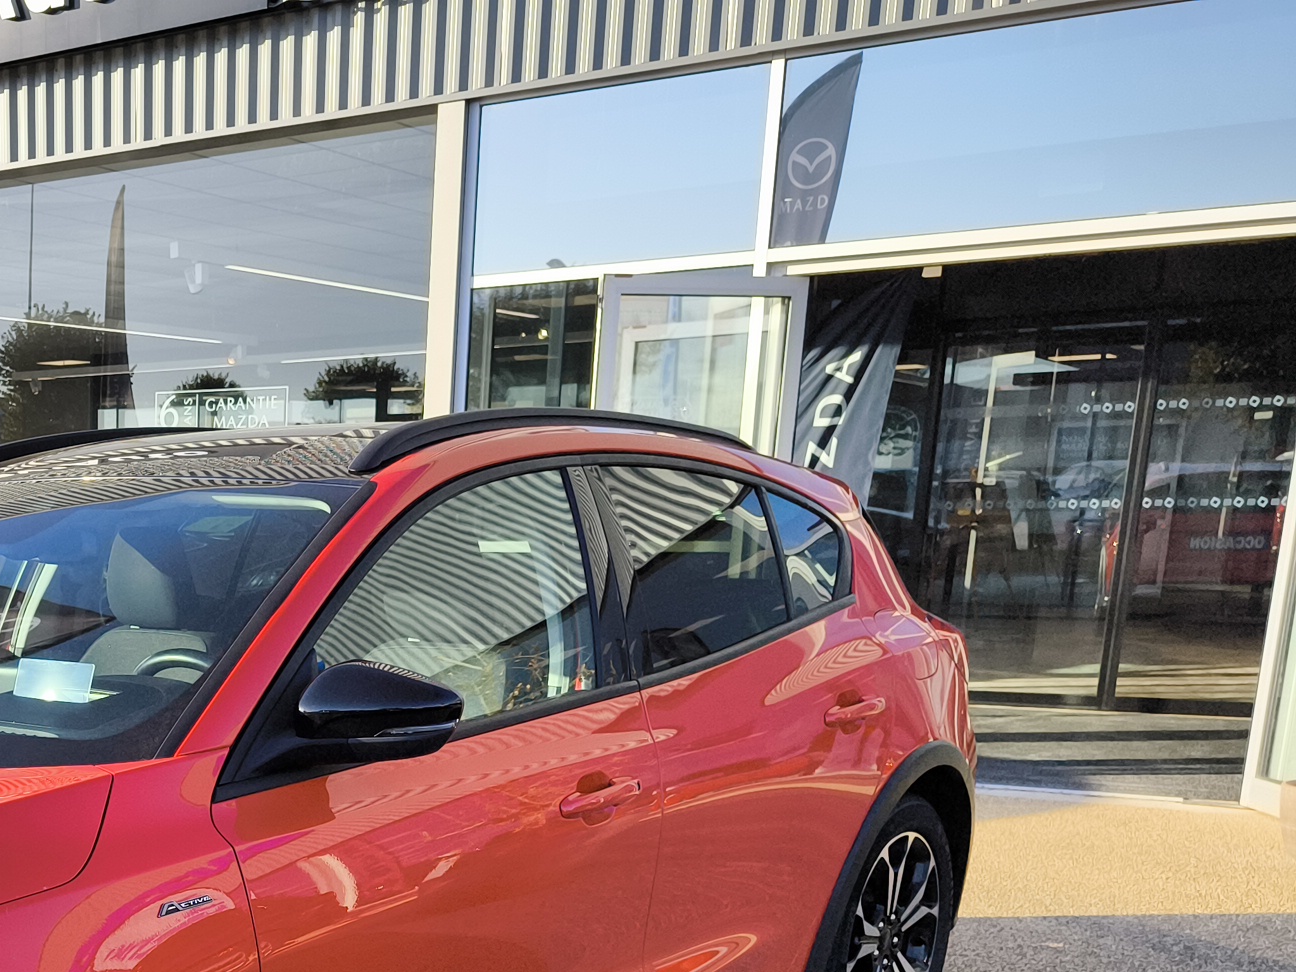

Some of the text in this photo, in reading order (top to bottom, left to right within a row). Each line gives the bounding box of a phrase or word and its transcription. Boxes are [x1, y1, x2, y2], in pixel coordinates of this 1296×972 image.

[159, 394, 193, 428] 6 ANS
[204, 395, 278, 412] GARANTIE
[212, 414, 270, 429] MAZDA
